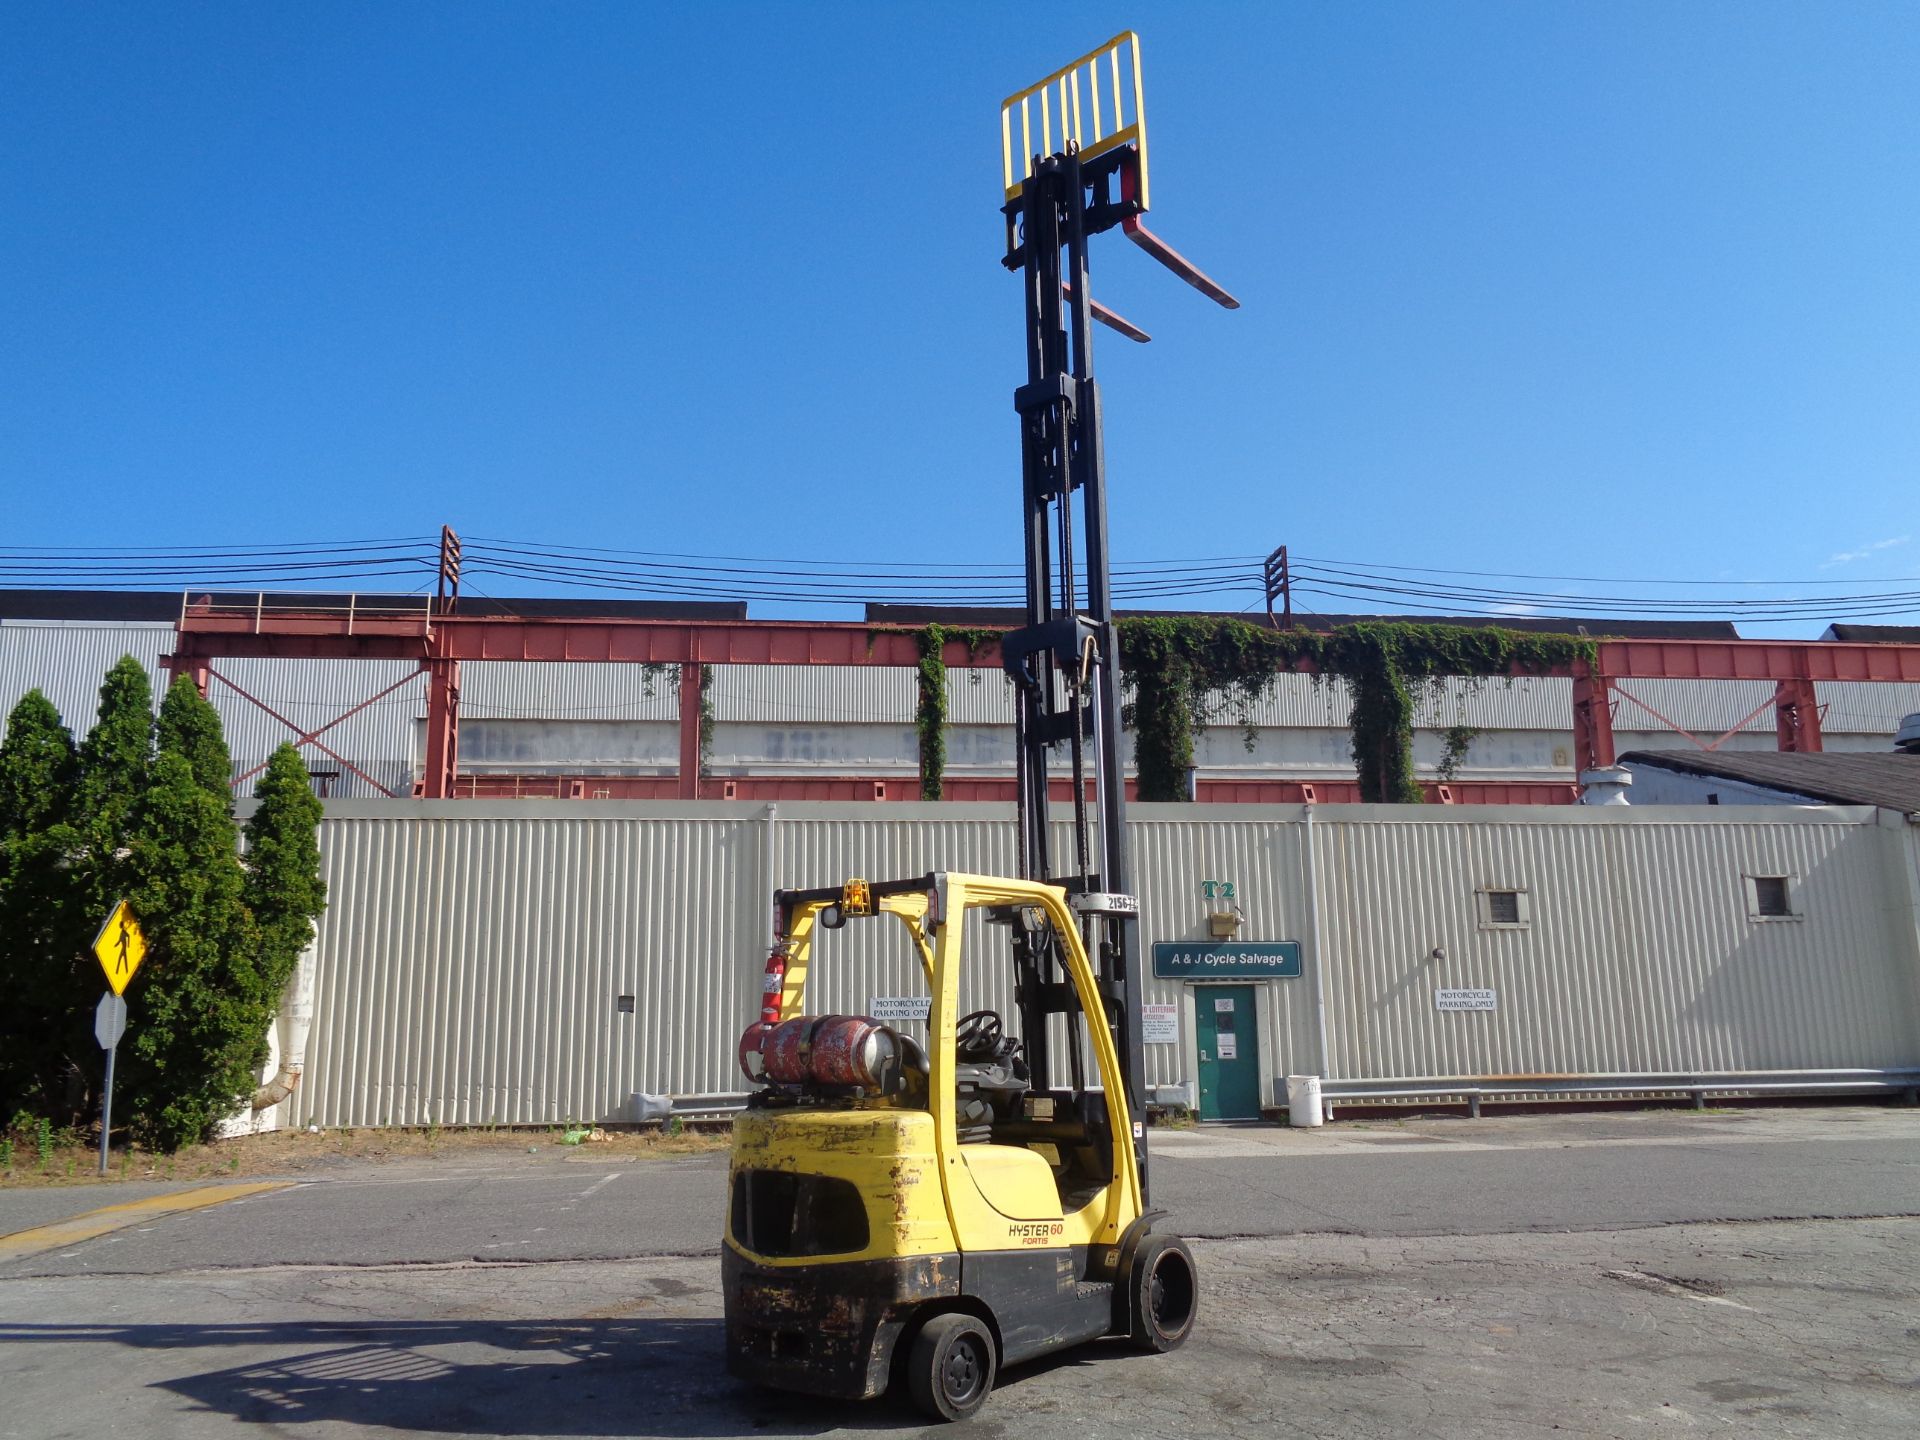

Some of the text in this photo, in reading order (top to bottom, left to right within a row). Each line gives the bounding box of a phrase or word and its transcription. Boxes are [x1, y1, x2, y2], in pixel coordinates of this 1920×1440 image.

[1172, 953, 1283, 966] A & J Cycle Salvage
[1440, 991, 1491, 999] MOTORCYCLE
[875, 1000, 930, 1008] MOTORCYCLE
[1439, 1000, 1494, 1008] PARKING ONLY
[873, 1009, 910, 1017] PARKING
[1009, 1223, 1063, 1236] HYSTER 60
